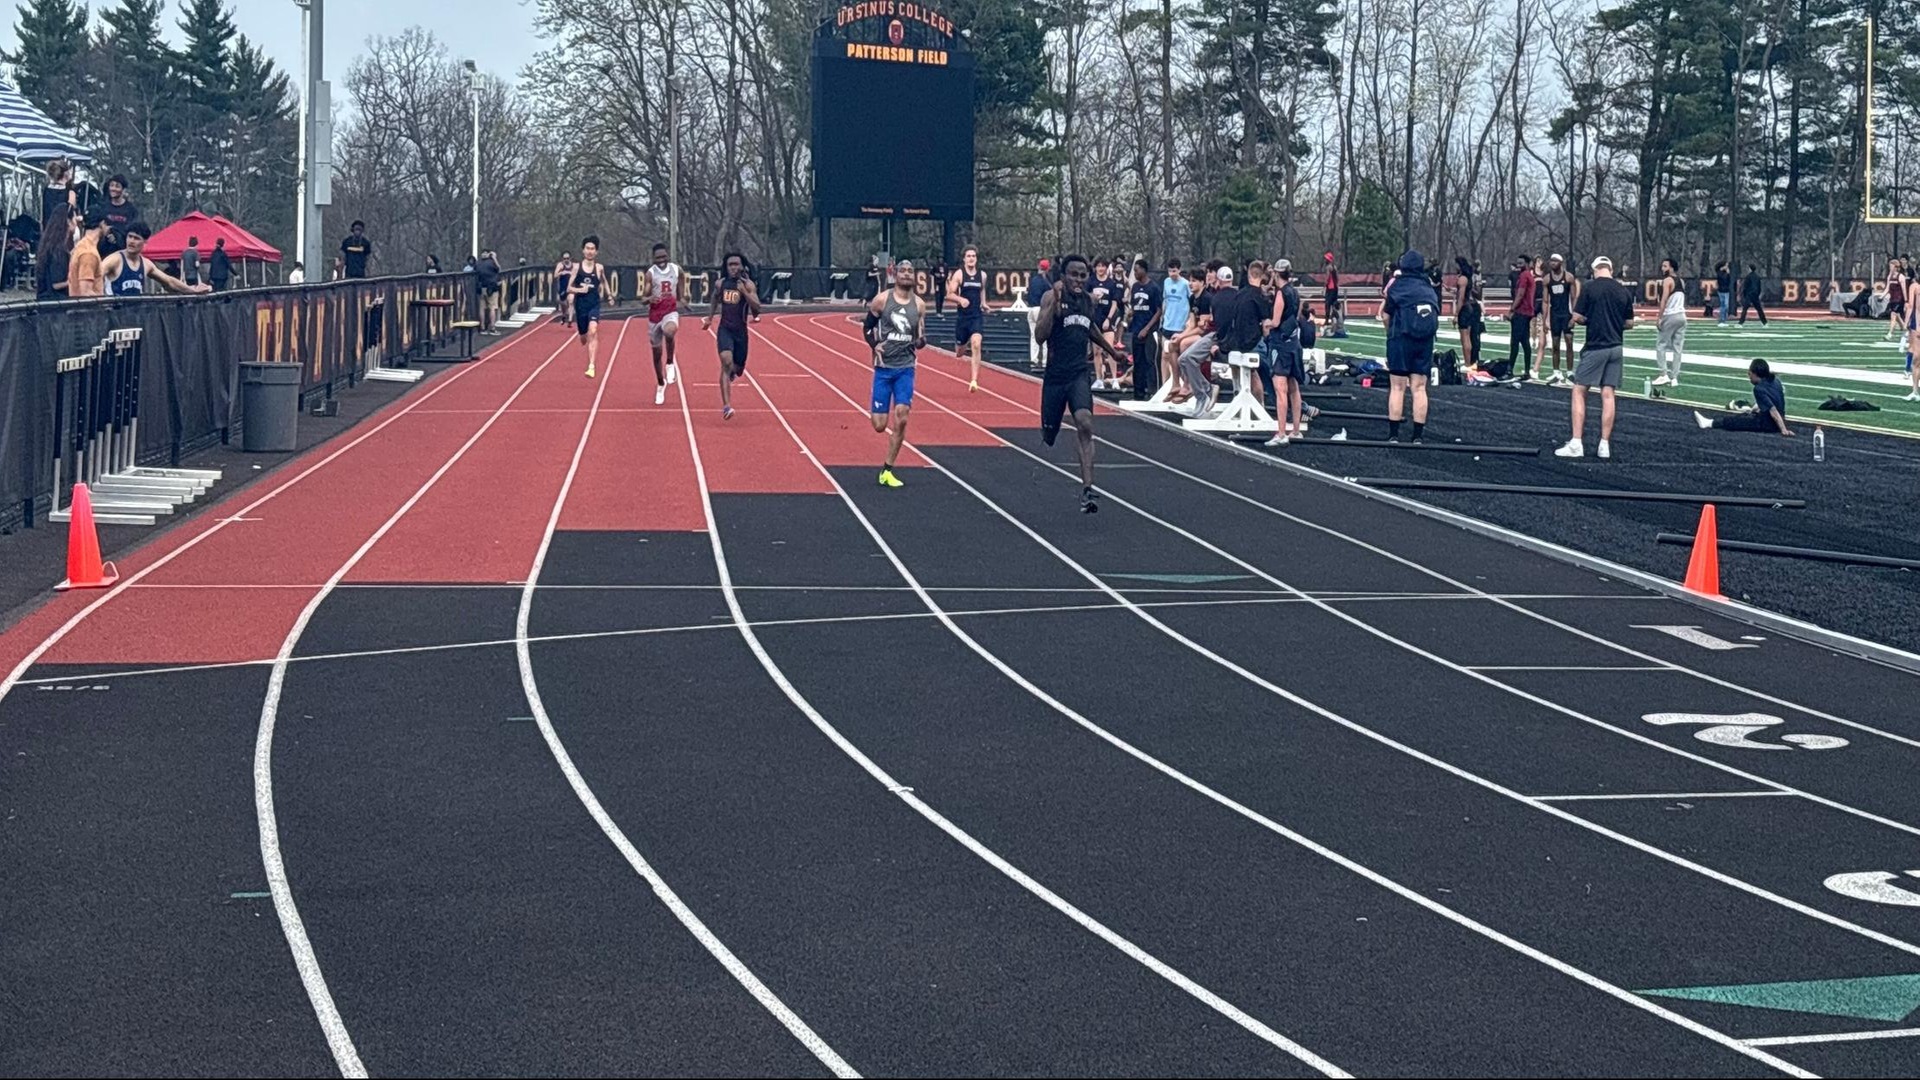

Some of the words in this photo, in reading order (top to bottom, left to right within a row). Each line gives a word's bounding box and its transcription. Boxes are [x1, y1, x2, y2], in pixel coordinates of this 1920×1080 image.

[837, 1, 895, 26] URSINUS
[899, 3, 953, 38] COLLEGE
[847, 43, 914, 62] PATTERSON
[917, 49, 948, 65] FIELD
[1640, 712, 1850, 750] 2
